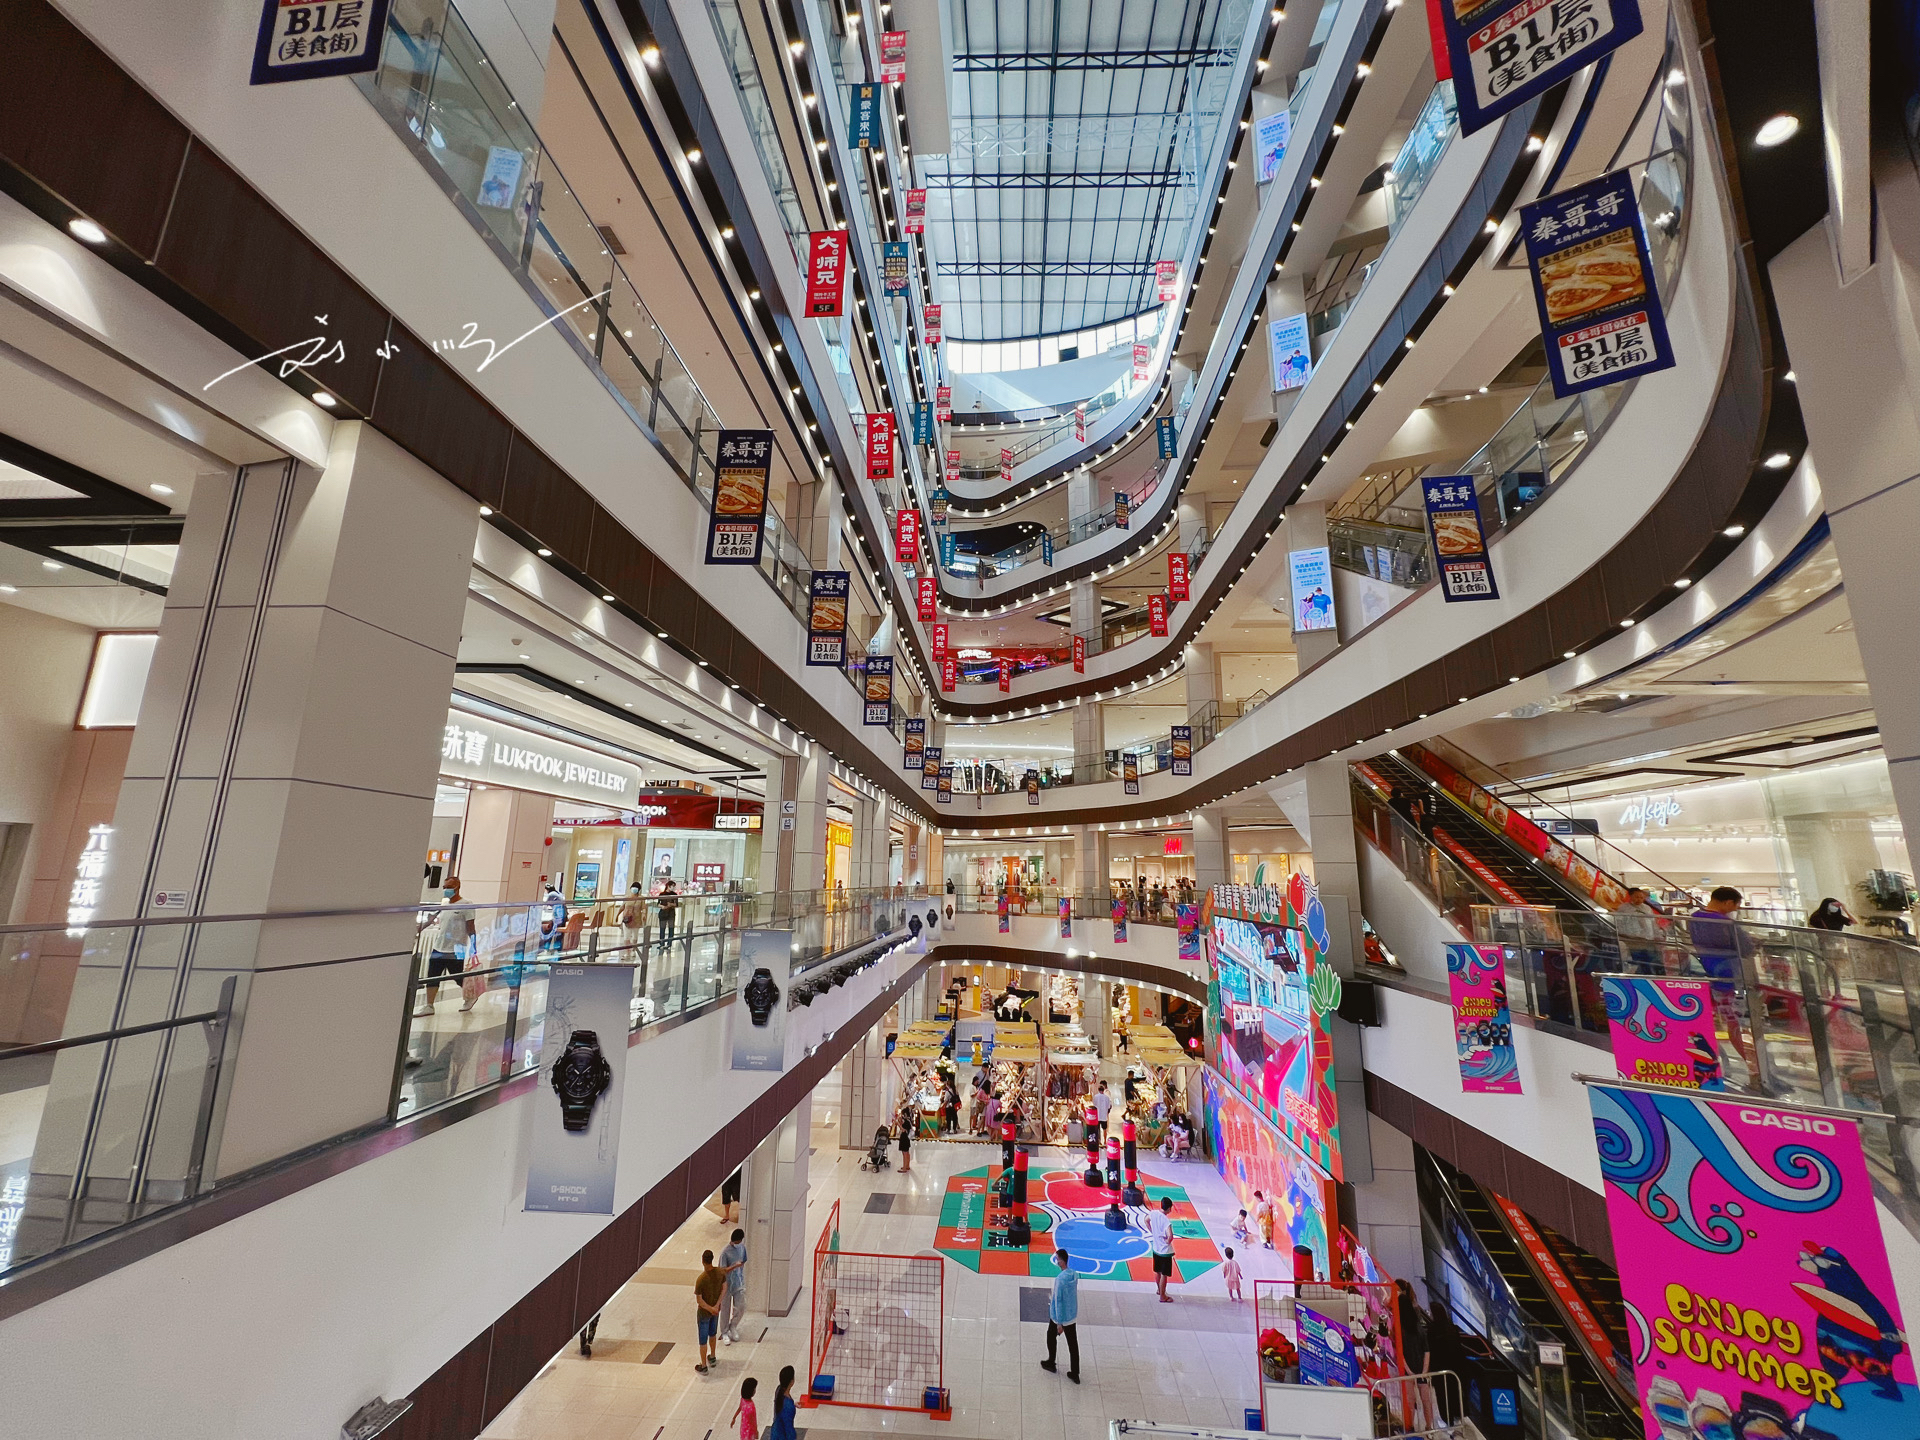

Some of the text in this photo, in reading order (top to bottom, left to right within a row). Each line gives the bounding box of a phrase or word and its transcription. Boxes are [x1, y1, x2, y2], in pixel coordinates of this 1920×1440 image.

[284, 1, 364, 36] B1层
[278, 32, 358, 61] (美食街)
[1484, 0, 1593, 74] B1层
[1488, 17, 1599, 97] (美食街)
[1569, 326, 1644, 365] B1层
[1573, 347, 1648, 379] (美食街)
[716, 546, 752, 557] (美食街)
[718, 533, 753, 546] B1层
[1450, 571, 1485, 584] B1层
[815, 643, 839, 653] B1层
[493, 742, 563, 778] LUKFOOK
[563, 763, 628, 792] JEWELLERY
[740, 816, 747, 826] P
[1665, 981, 1702, 989] CASIO
[1739, 1109, 1836, 1136] CASIO
[551, 1185, 587, 1195] G-SHOCK
